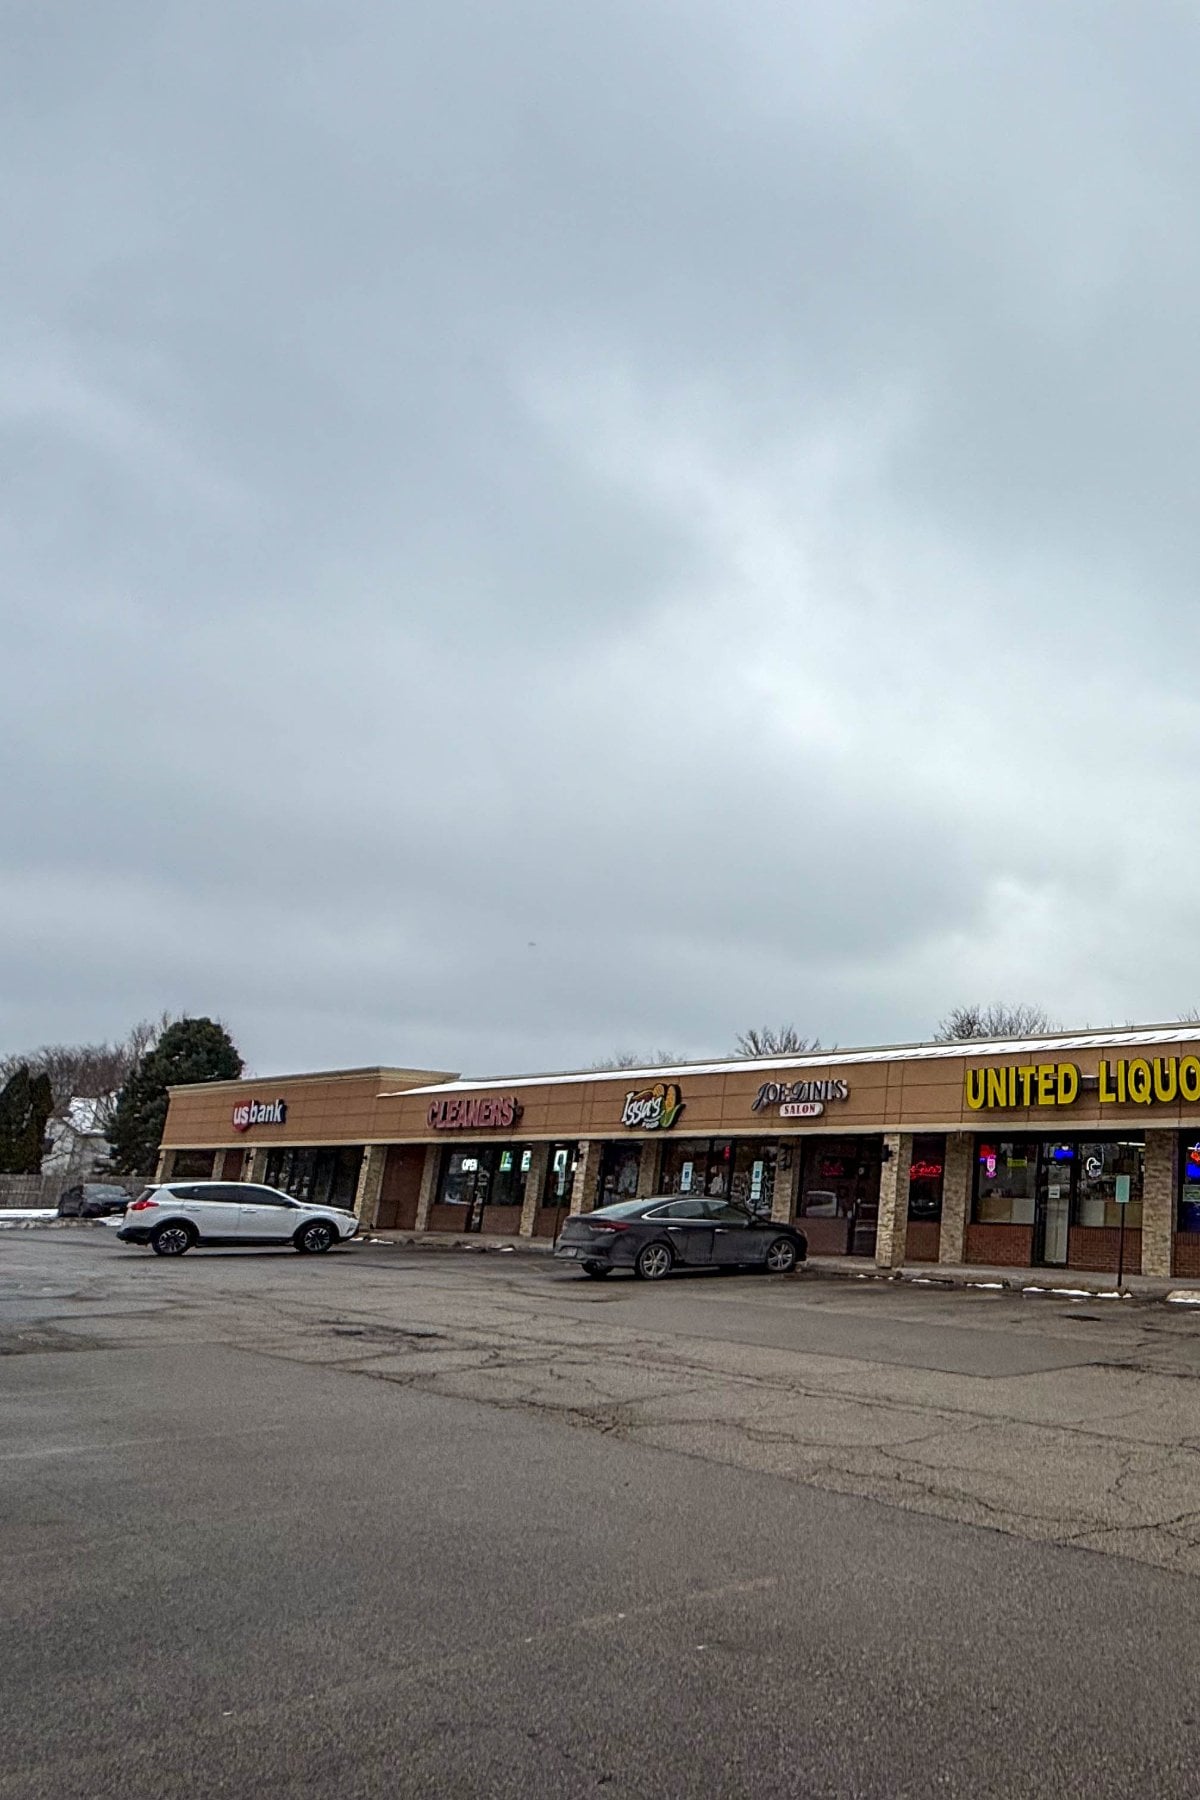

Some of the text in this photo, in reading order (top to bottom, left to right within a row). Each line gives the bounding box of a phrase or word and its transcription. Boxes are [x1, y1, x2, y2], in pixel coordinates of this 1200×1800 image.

[966, 1061, 1079, 1109] UNITED
[427, 1097, 515, 1128] CLEANERS
[784, 1104, 816, 1115] SALON
